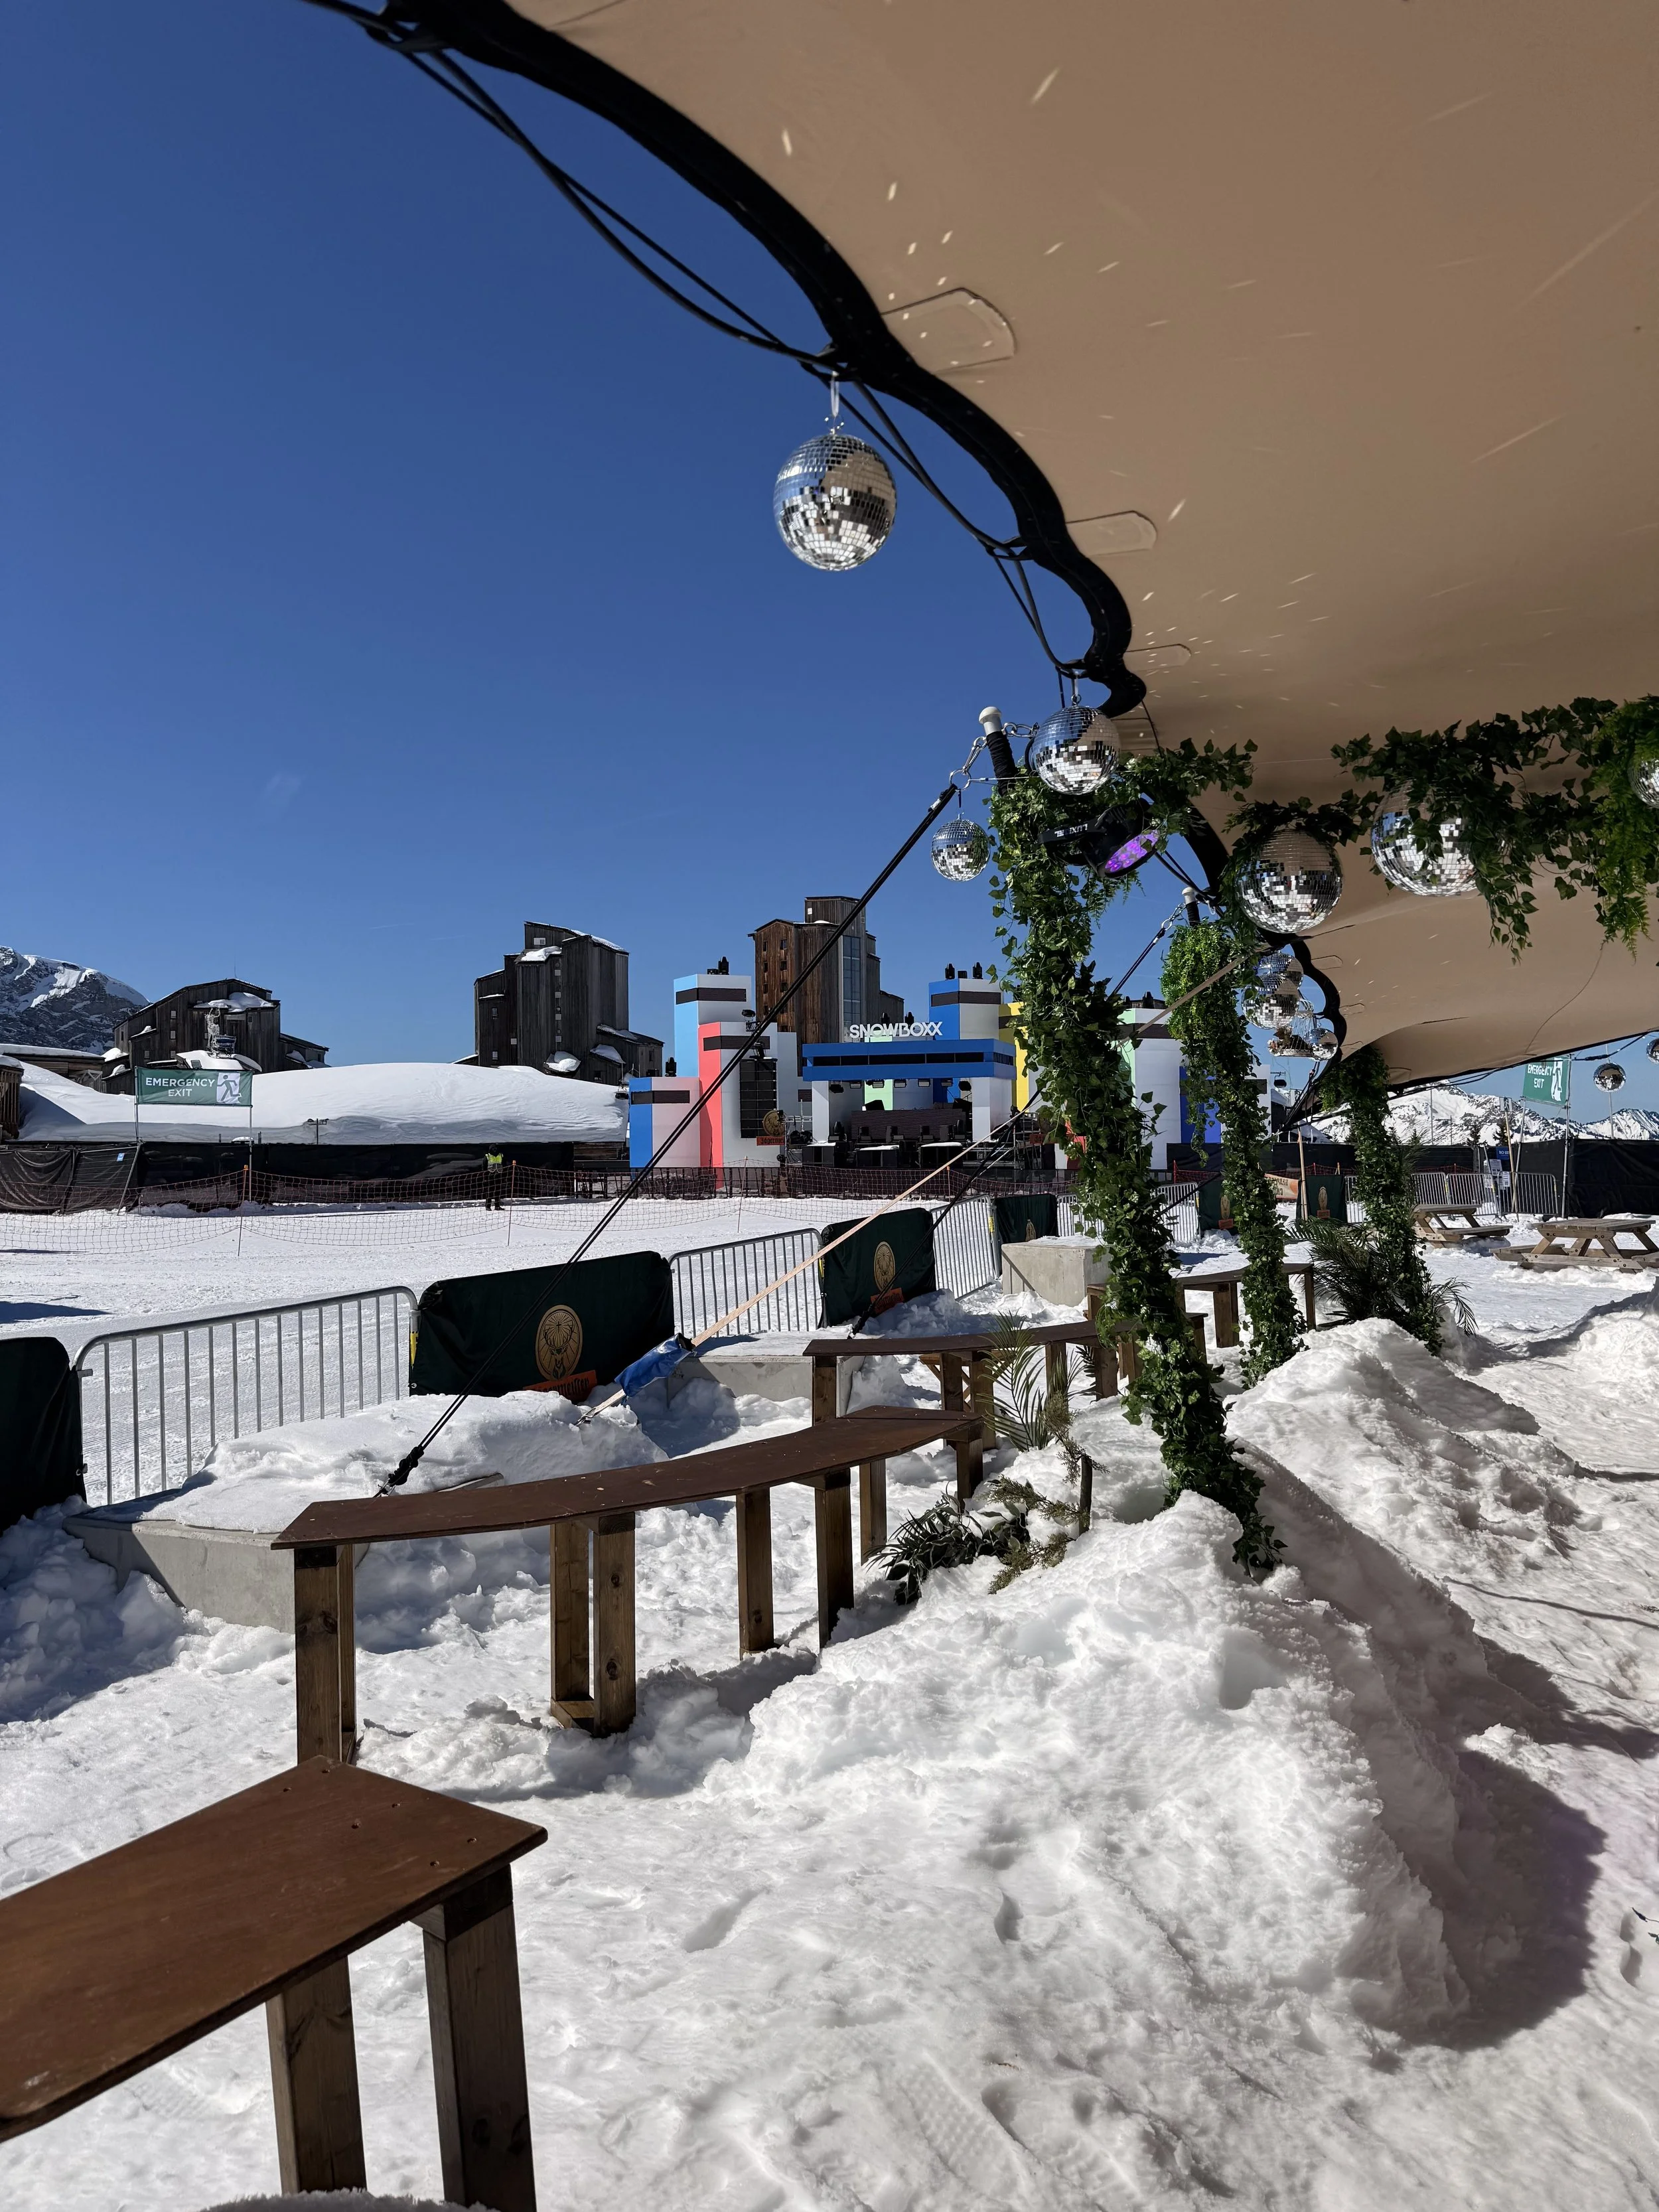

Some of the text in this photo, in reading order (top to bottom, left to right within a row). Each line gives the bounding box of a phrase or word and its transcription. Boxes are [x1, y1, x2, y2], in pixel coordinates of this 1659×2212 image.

[849, 1021, 942, 1039] SNOWBOXX
[145, 1077, 215, 1087] EMERGENCY
[1534, 1078, 1545, 1088] EXIT
